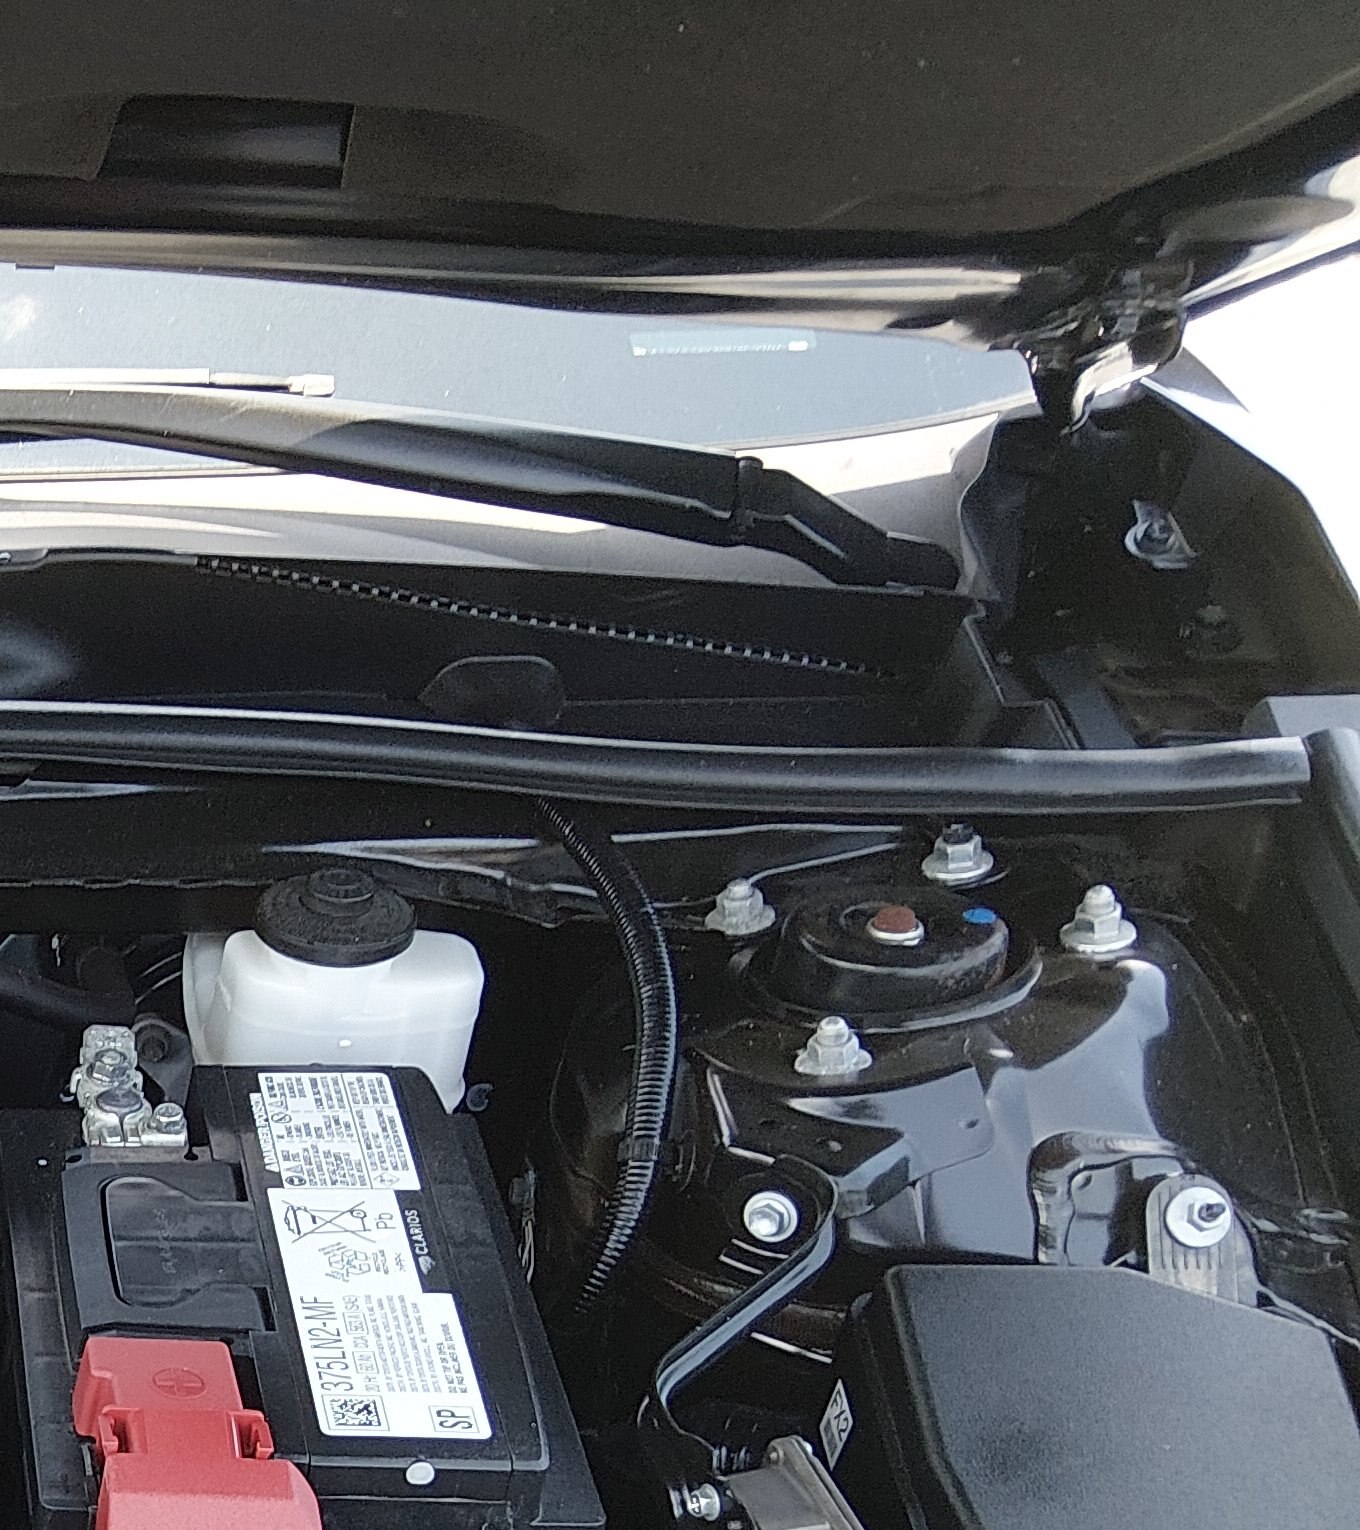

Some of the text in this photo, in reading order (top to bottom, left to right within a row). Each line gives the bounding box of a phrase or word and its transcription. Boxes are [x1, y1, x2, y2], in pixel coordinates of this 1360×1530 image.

[372, 1212, 396, 1229] Pb
[403, 1209, 429, 1254] CLARIOS
[299, 1295, 354, 1391] 375LN2-MF
[434, 1408, 473, 1429] SP
